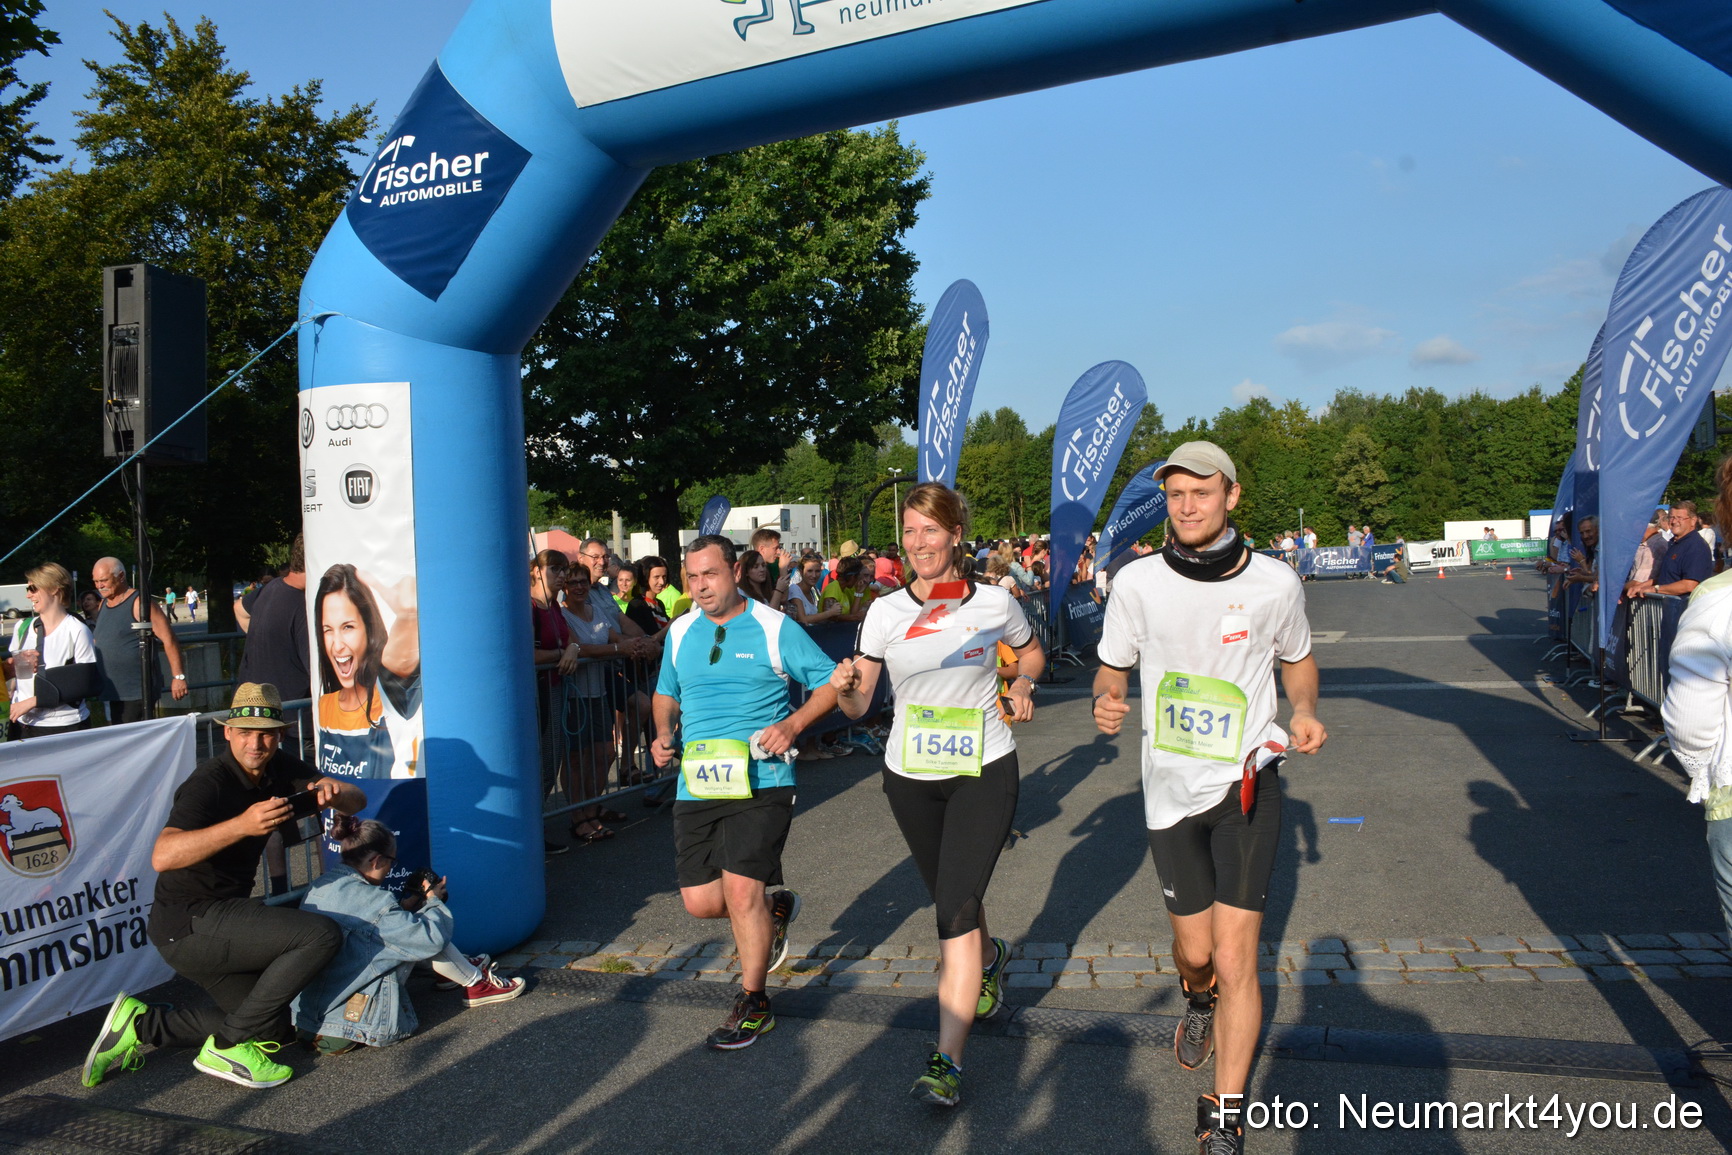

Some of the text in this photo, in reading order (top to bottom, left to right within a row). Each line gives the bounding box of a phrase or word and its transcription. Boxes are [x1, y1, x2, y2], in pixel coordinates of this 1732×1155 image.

[373, 151, 490, 194] Fischer
[379, 178, 483, 208] AUTOMOBILE
[1639, 223, 1732, 409] Fischer
[933, 311, 971, 459] Fischer
[948, 335, 977, 456] AUTOMOBILE
[328, 437, 352, 447] Audi
[1073, 382, 1124, 484] Fischer
[1092, 399, 1132, 482] AUTOMOBILE
[348, 476, 371, 497] FIAT
[1107, 492, 1166, 538] Frischmann
[1322, 557, 1360, 566] Fischer
[1431, 546, 1455, 559] swn
[1475, 542, 1495, 554] AOK
[1165, 703, 1232, 739] 1531
[912, 732, 974, 757] 1548
[324, 756, 368, 779] Fischer
[696, 763, 733, 782] 417
[24, 849, 60, 870] 1628
[0, 877, 138, 937] umarkter
[0, 905, 151, 991] mmsbrä
